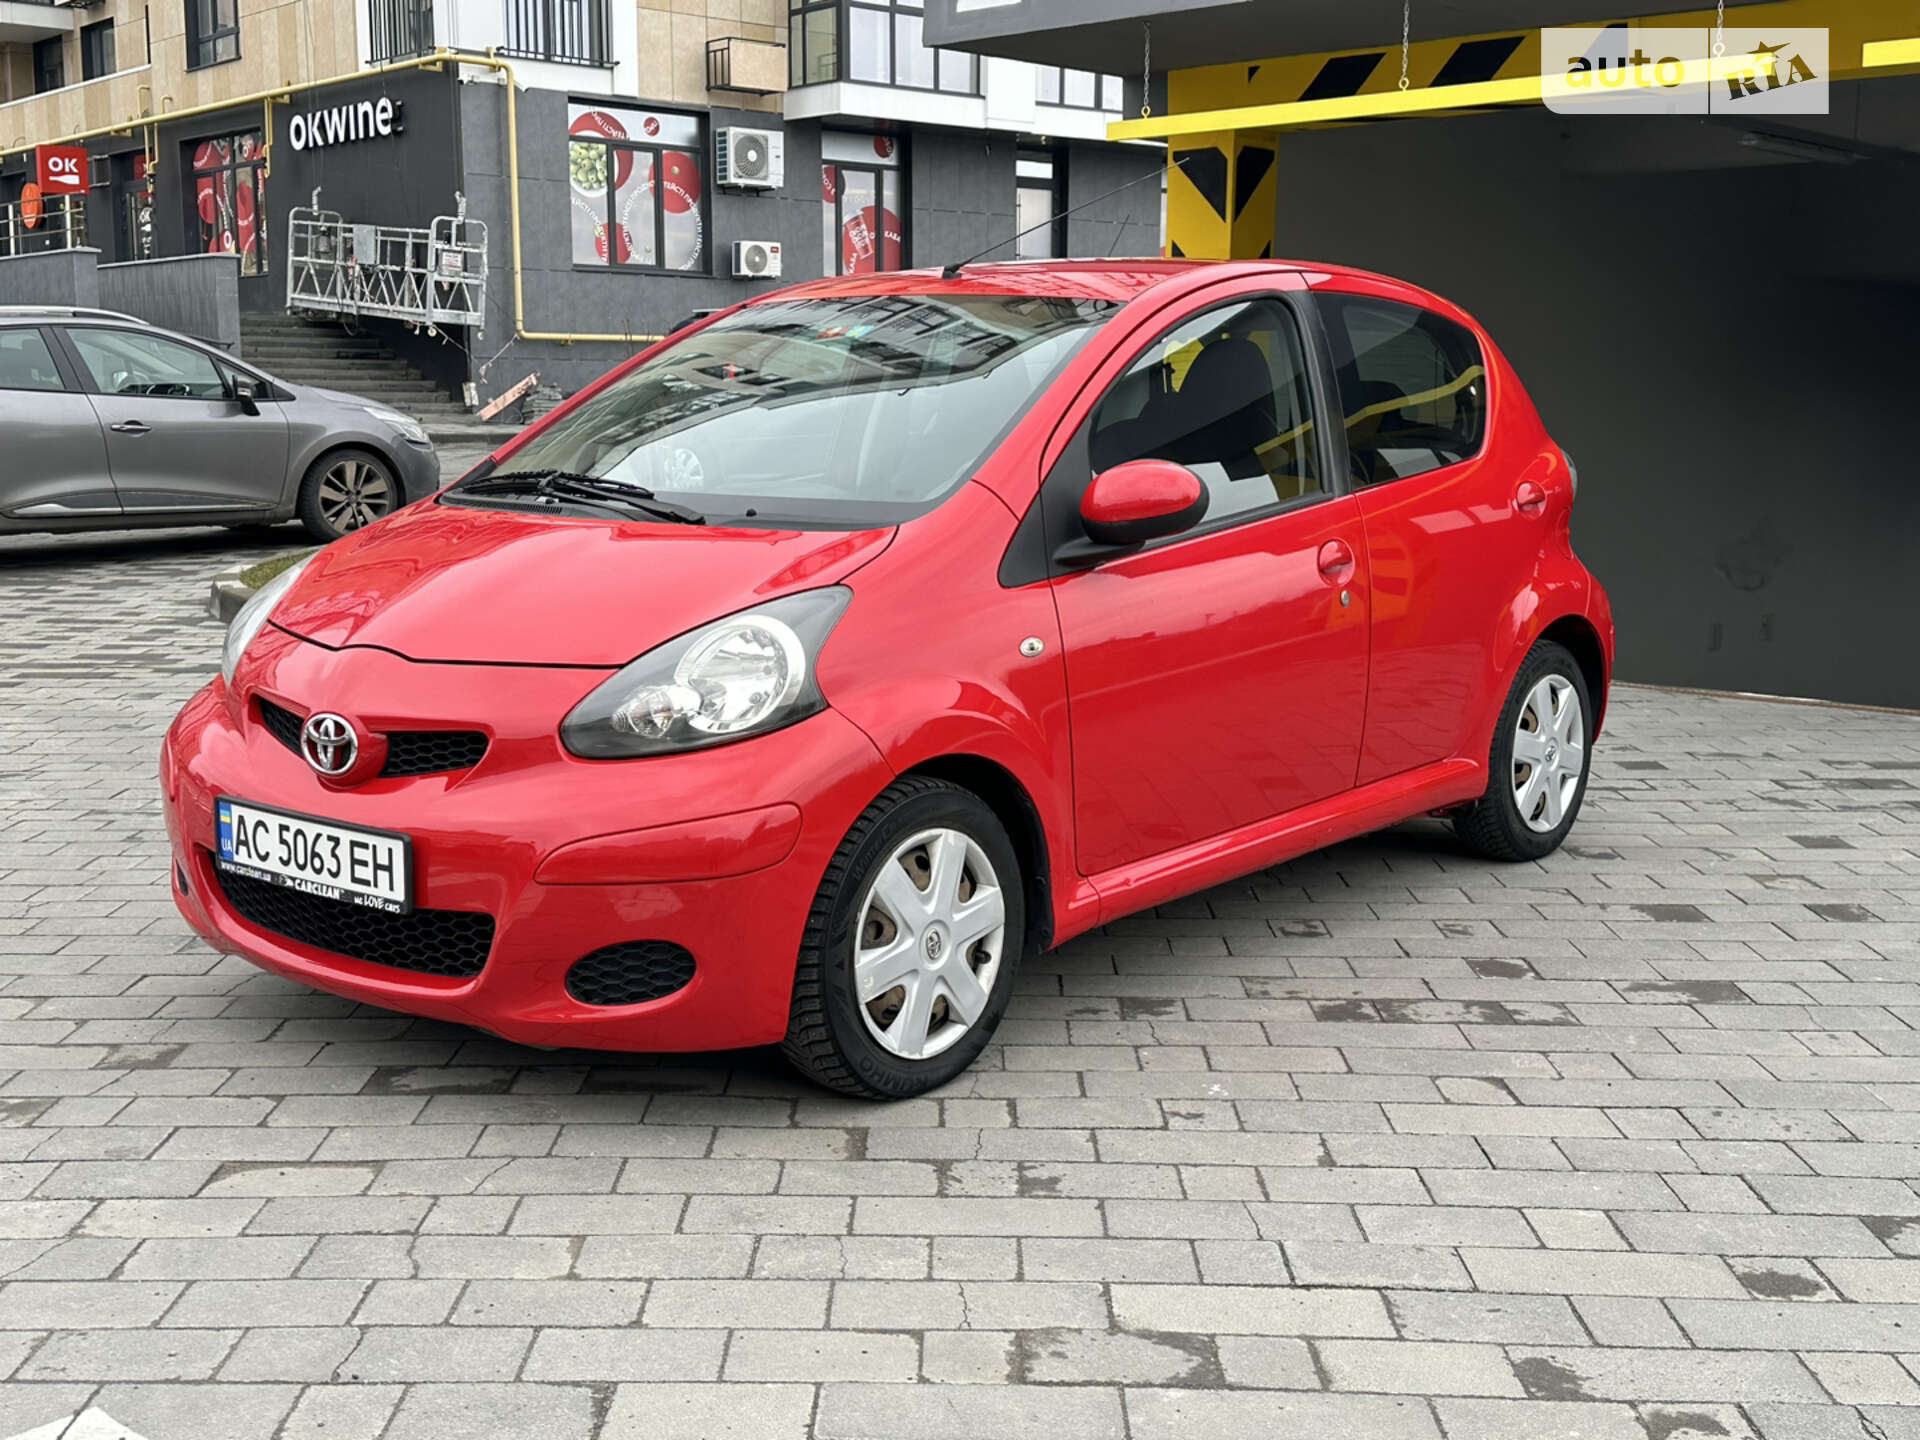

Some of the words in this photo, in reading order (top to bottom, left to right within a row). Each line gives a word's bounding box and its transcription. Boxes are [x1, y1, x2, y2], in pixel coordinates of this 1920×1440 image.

[48, 156, 79, 173] OK
[221, 838, 232, 852] UA
[235, 814, 270, 862] AC
[278, 823, 341, 879] 5063
[349, 840, 394, 892] EH
